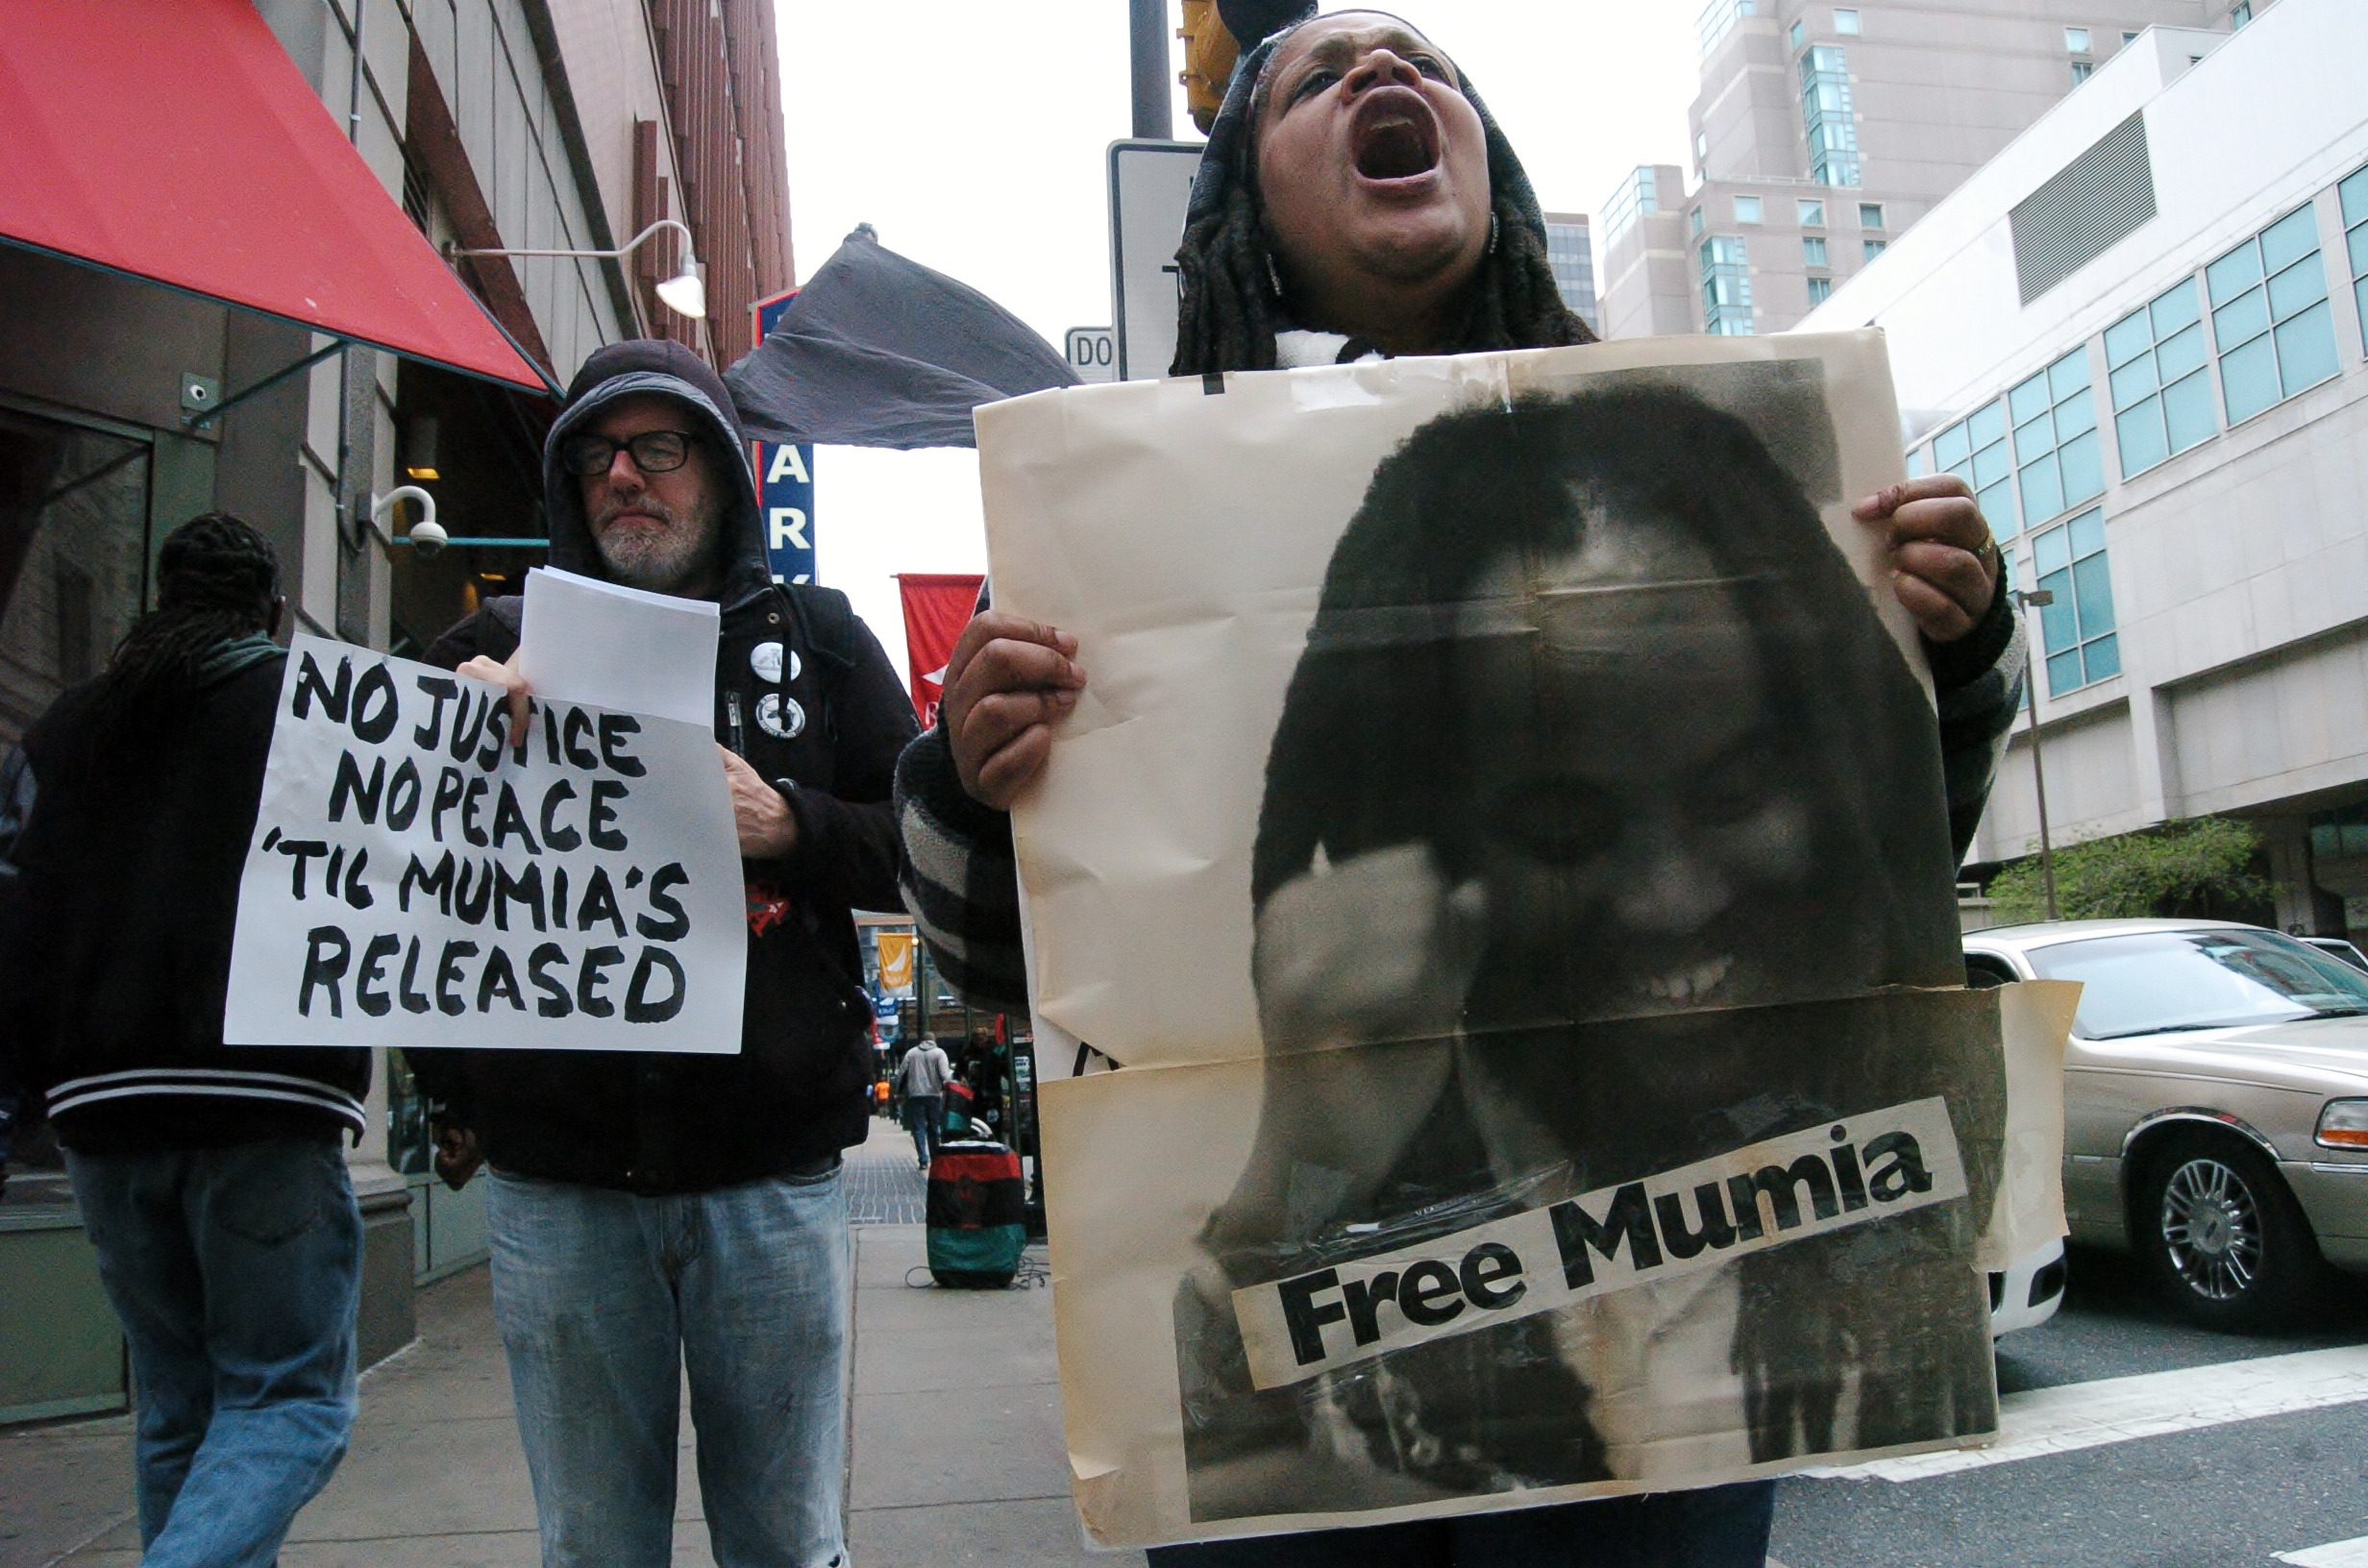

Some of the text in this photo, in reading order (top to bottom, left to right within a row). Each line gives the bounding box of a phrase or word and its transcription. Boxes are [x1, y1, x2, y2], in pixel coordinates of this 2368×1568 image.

[1076, 336, 1112, 366] DO
[291, 650, 399, 745] NO
[328, 748, 629, 856] NO PEACE
[399, 847, 691, 943] MUMIA'S
[298, 925, 686, 1024] RELEASED
[1276, 1123, 1934, 1366] Free Mumia
